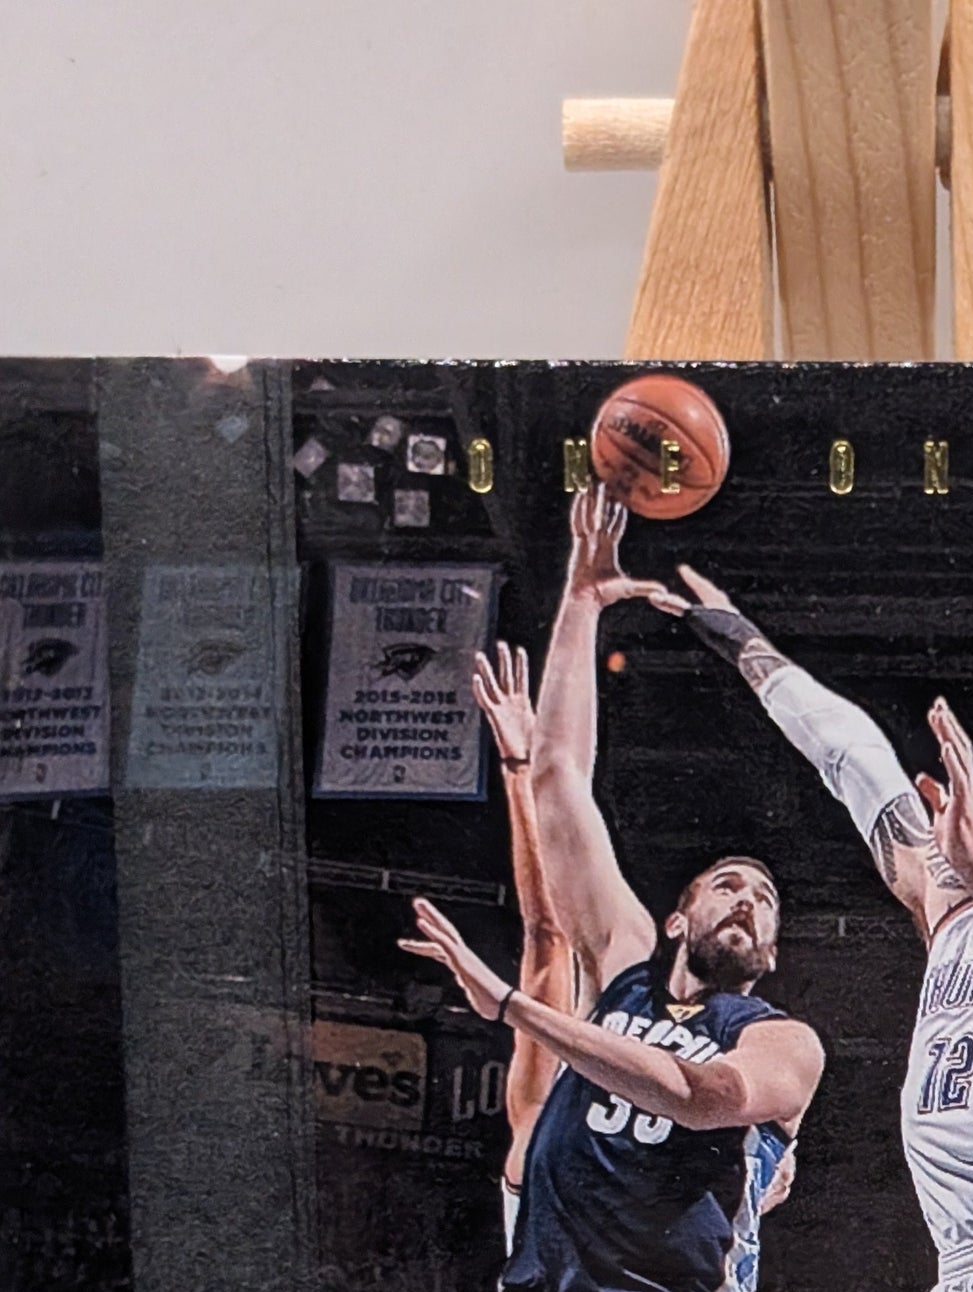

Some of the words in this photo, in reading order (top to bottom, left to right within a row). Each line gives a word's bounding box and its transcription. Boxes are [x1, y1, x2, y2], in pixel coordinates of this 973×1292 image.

[339, 709, 466, 724] NORTHWEST
[356, 727, 449, 743] DIVISION
[340, 745, 462, 761] CHAMPIONS
